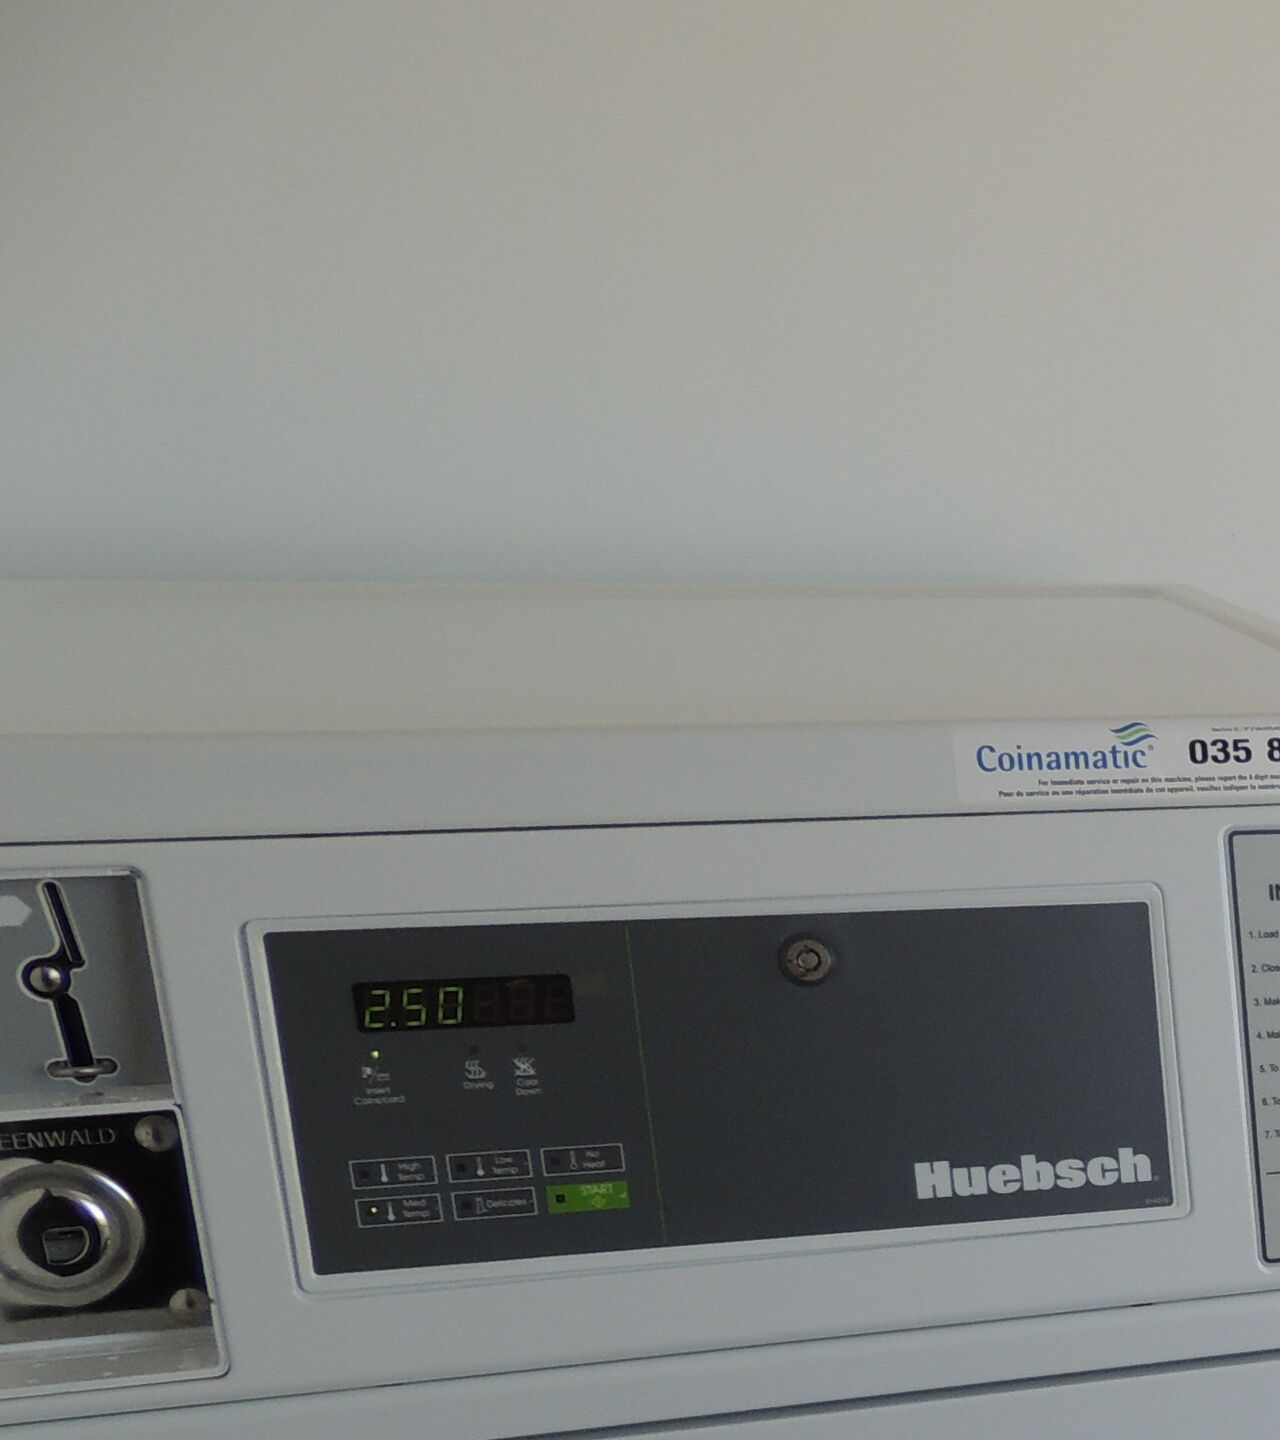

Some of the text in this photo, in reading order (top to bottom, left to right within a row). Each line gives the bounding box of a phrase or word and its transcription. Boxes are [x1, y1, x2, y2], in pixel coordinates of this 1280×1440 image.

[1188, 738, 1252, 765] 035
[976, 744, 1148, 772] Coinamatic
[1249, 931, 1255, 939] 1.
[1259, 931, 1278, 939] Load
[1252, 965, 1258, 973] 2.
[363, 985, 464, 1029] 2.50
[1254, 998, 1261, 1006] 3.
[1257, 1031, 1265, 1039] 4.
[1260, 1065, 1267, 1073] 5.
[1270, 1064, 1278, 1072] To
[464, 1081, 494, 1090] Drying
[1262, 1098, 1269, 1106] 6.
[1273, 1097, 1280, 1105] To
[1265, 1130, 1272, 1139] 7.
[398, 1162, 421, 1172] High
[493, 1166, 519, 1176] Temp
[398, 1172, 425, 1182] Temp
[913, 1147, 1154, 1199] Huebsch
[580, 1184, 614, 1195] START
[403, 1198, 426, 1208] Med
[403, 1208, 430, 1218] Temp
